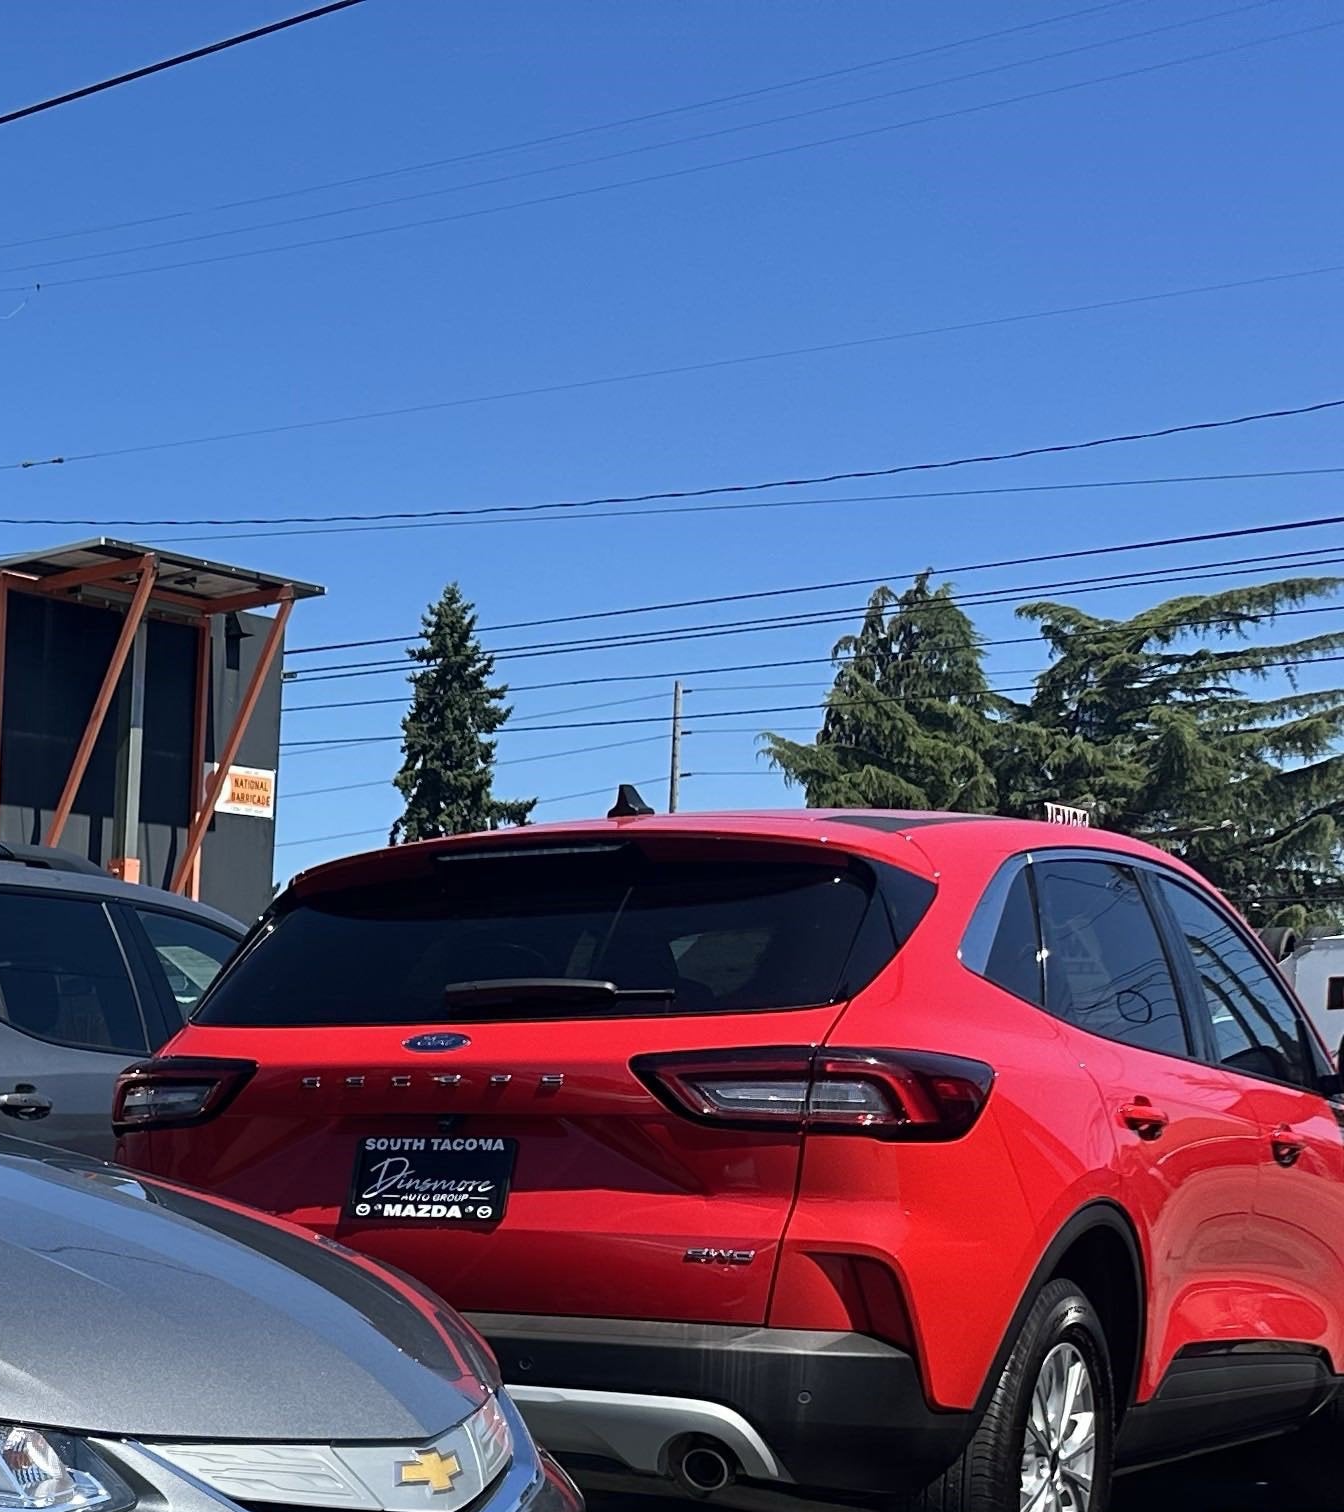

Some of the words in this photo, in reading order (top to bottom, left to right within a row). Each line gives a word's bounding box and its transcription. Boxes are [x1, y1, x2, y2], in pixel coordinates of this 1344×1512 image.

[234, 777, 269, 792] NATIONAL
[365, 1138, 425, 1151] SOUTH
[431, 1138, 505, 1151] TACOMA
[362, 1156, 495, 1199] Dinsmore
[401, 1193, 430, 1201] AUTO
[433, 1193, 469, 1202] GROUP
[383, 1204, 462, 1218] MAZDA
